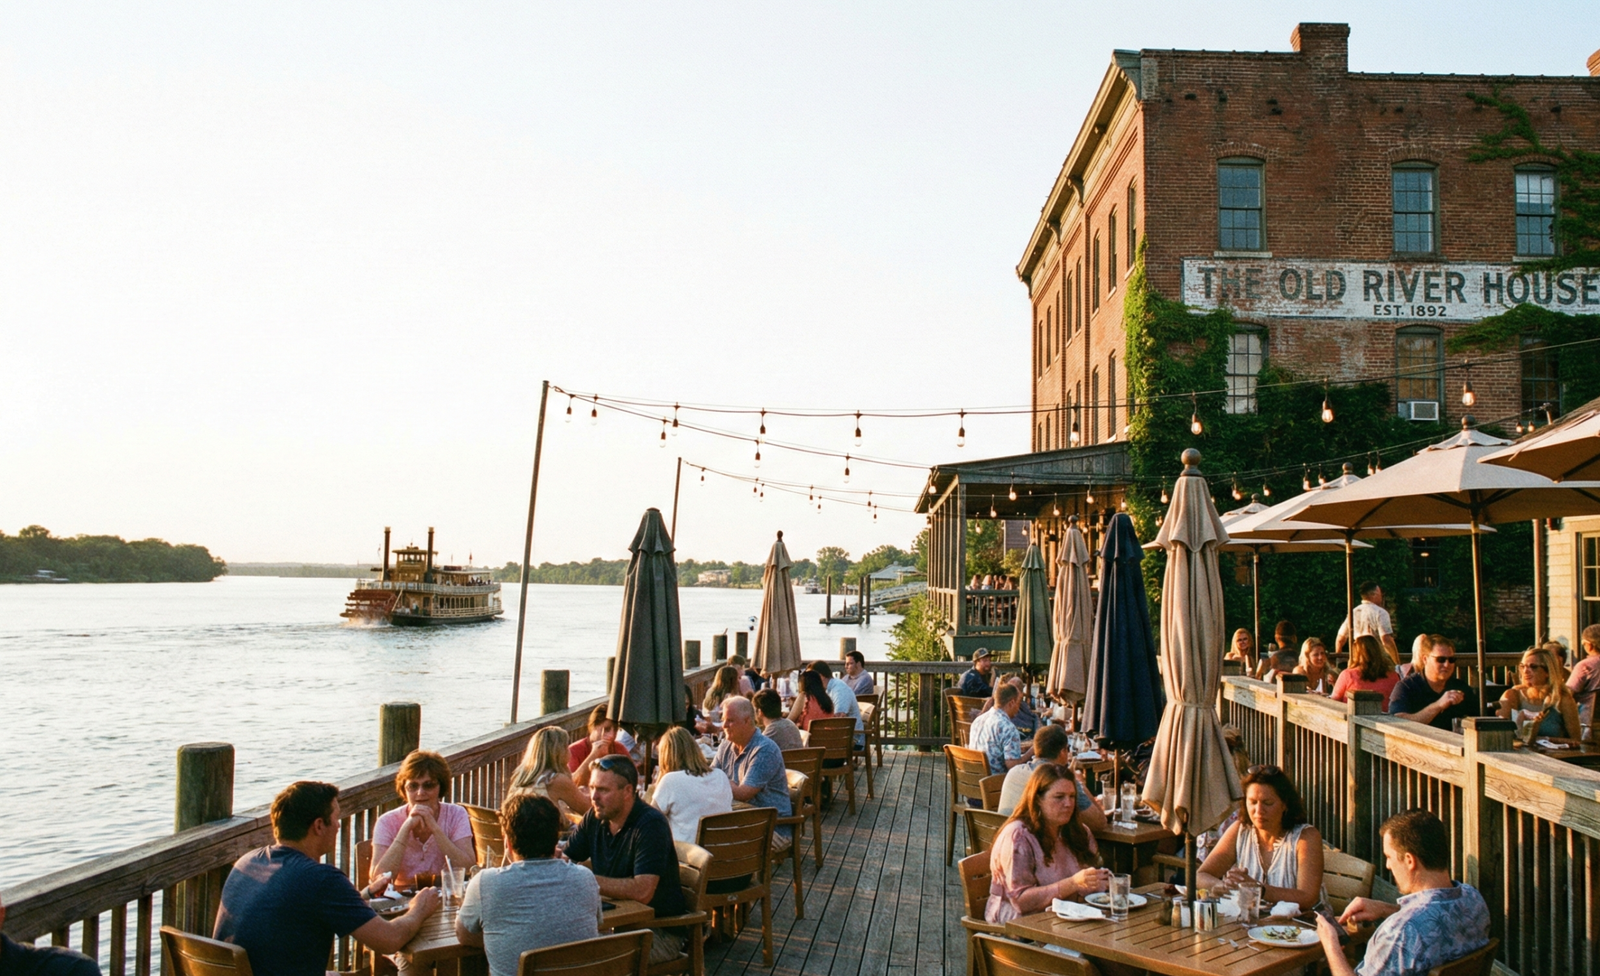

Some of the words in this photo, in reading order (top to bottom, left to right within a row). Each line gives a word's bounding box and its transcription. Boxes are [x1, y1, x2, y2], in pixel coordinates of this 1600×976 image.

[1200, 267, 1262, 300] THE
[1279, 267, 1347, 301] OLD
[1364, 269, 1467, 303] RIVER
[1483, 272, 1600, 305] HOUSE
[1373, 305, 1404, 316] EST.
[1410, 305, 1447, 317] 1892
